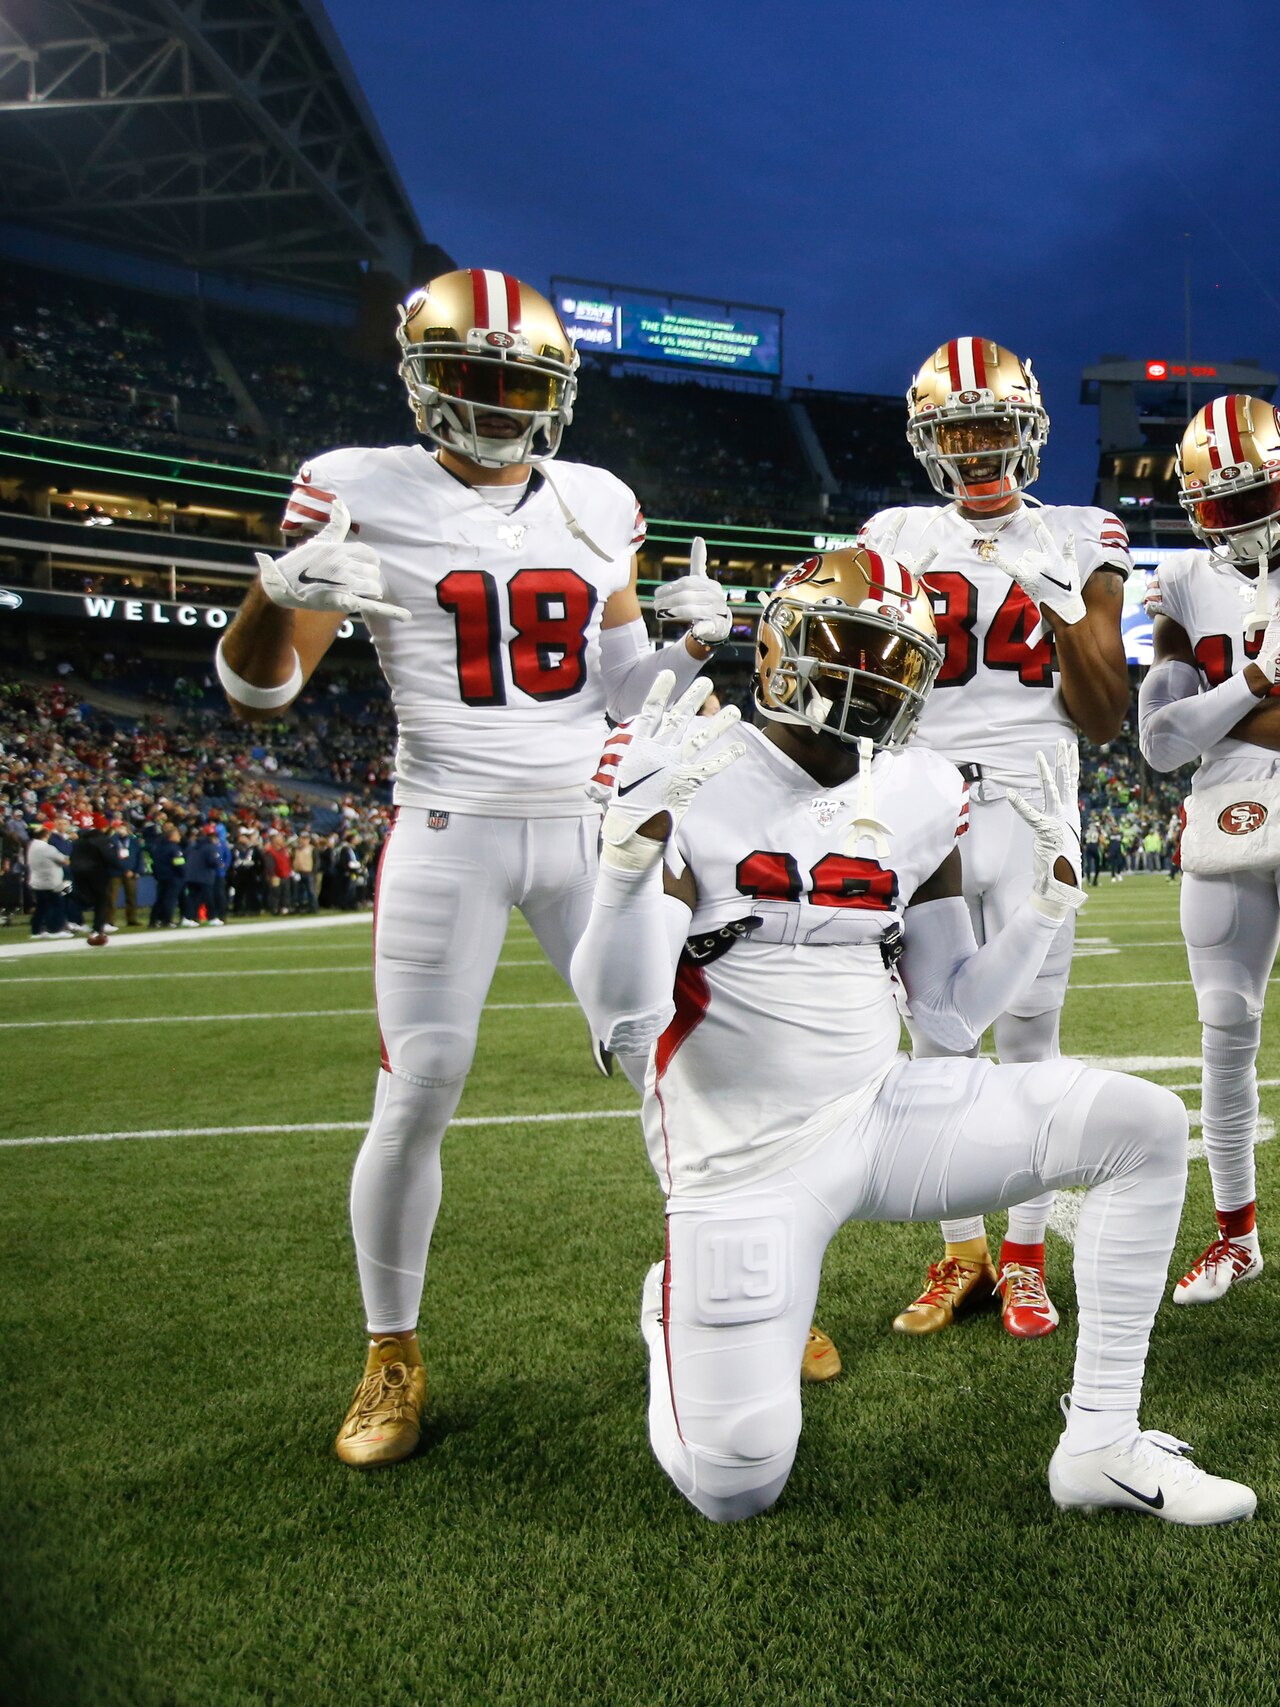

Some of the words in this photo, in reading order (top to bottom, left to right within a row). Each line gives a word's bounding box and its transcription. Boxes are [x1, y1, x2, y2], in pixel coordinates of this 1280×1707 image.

[660, 323, 711, 339] SEAHAWKS
[711, 330, 759, 346] GENERATE
[676, 338, 704, 351] MORE
[704, 341, 752, 357] PRESSURE
[435, 568, 598, 707] 18
[708, 1235, 778, 1300] 19
